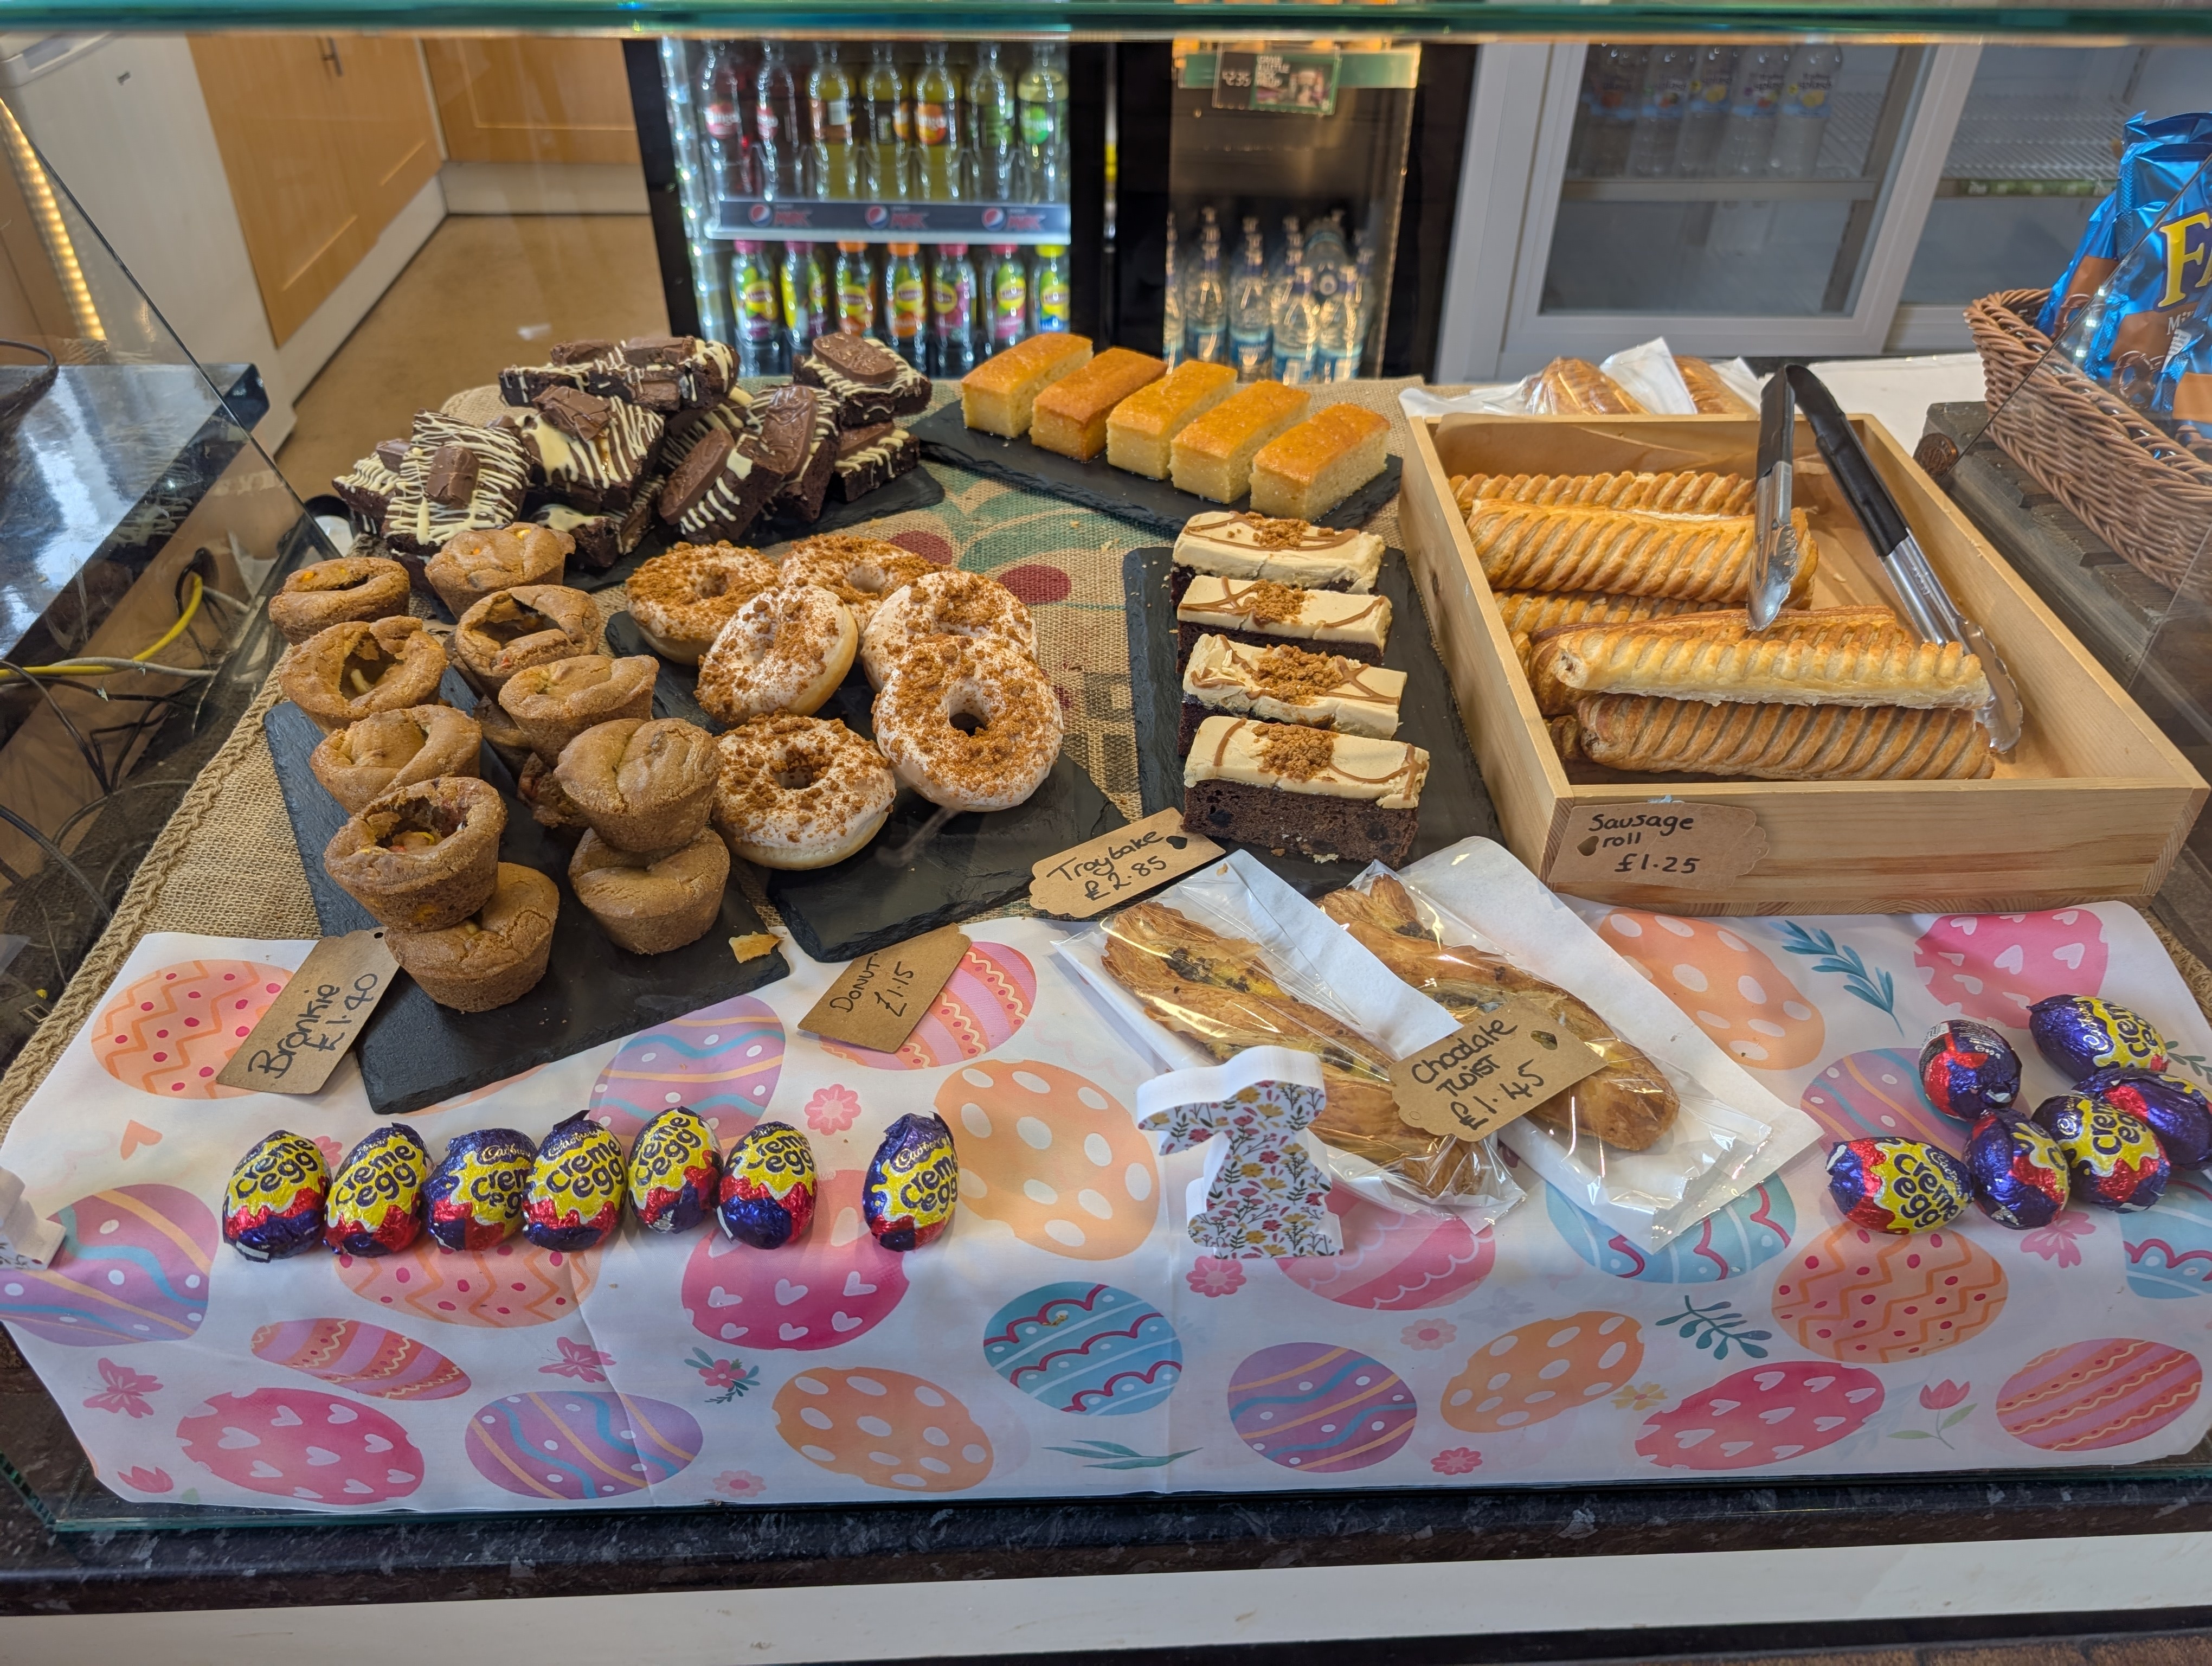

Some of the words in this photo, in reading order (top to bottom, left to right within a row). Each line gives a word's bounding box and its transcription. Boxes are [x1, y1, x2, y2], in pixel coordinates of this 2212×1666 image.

[1589, 813, 1694, 836] Sausage
[1602, 832, 1641, 848] roll
[1046, 831, 1165, 881] Traybake
[1085, 855, 1167, 901] £2.85
[1614, 853, 1701, 874] £1.25
[874, 961, 914, 1017] £1.15
[1450, 1059, 1544, 1131] £1.45
[236, 1139, 314, 1199] creme
[260, 1151, 319, 1193] egg
[546, 1138, 622, 1193] creme
[635, 1117, 691, 1186] creme
[652, 1129, 702, 1176] egg
[766, 1148, 815, 1176] egg
[335, 1145, 416, 1206] creme
[355, 1163, 417, 1207] egg
[572, 1157, 624, 1198] egg
[921, 1174, 958, 1214] egg
[1894, 1154, 1959, 1222] creme
[1893, 1177, 1942, 1228] egg
